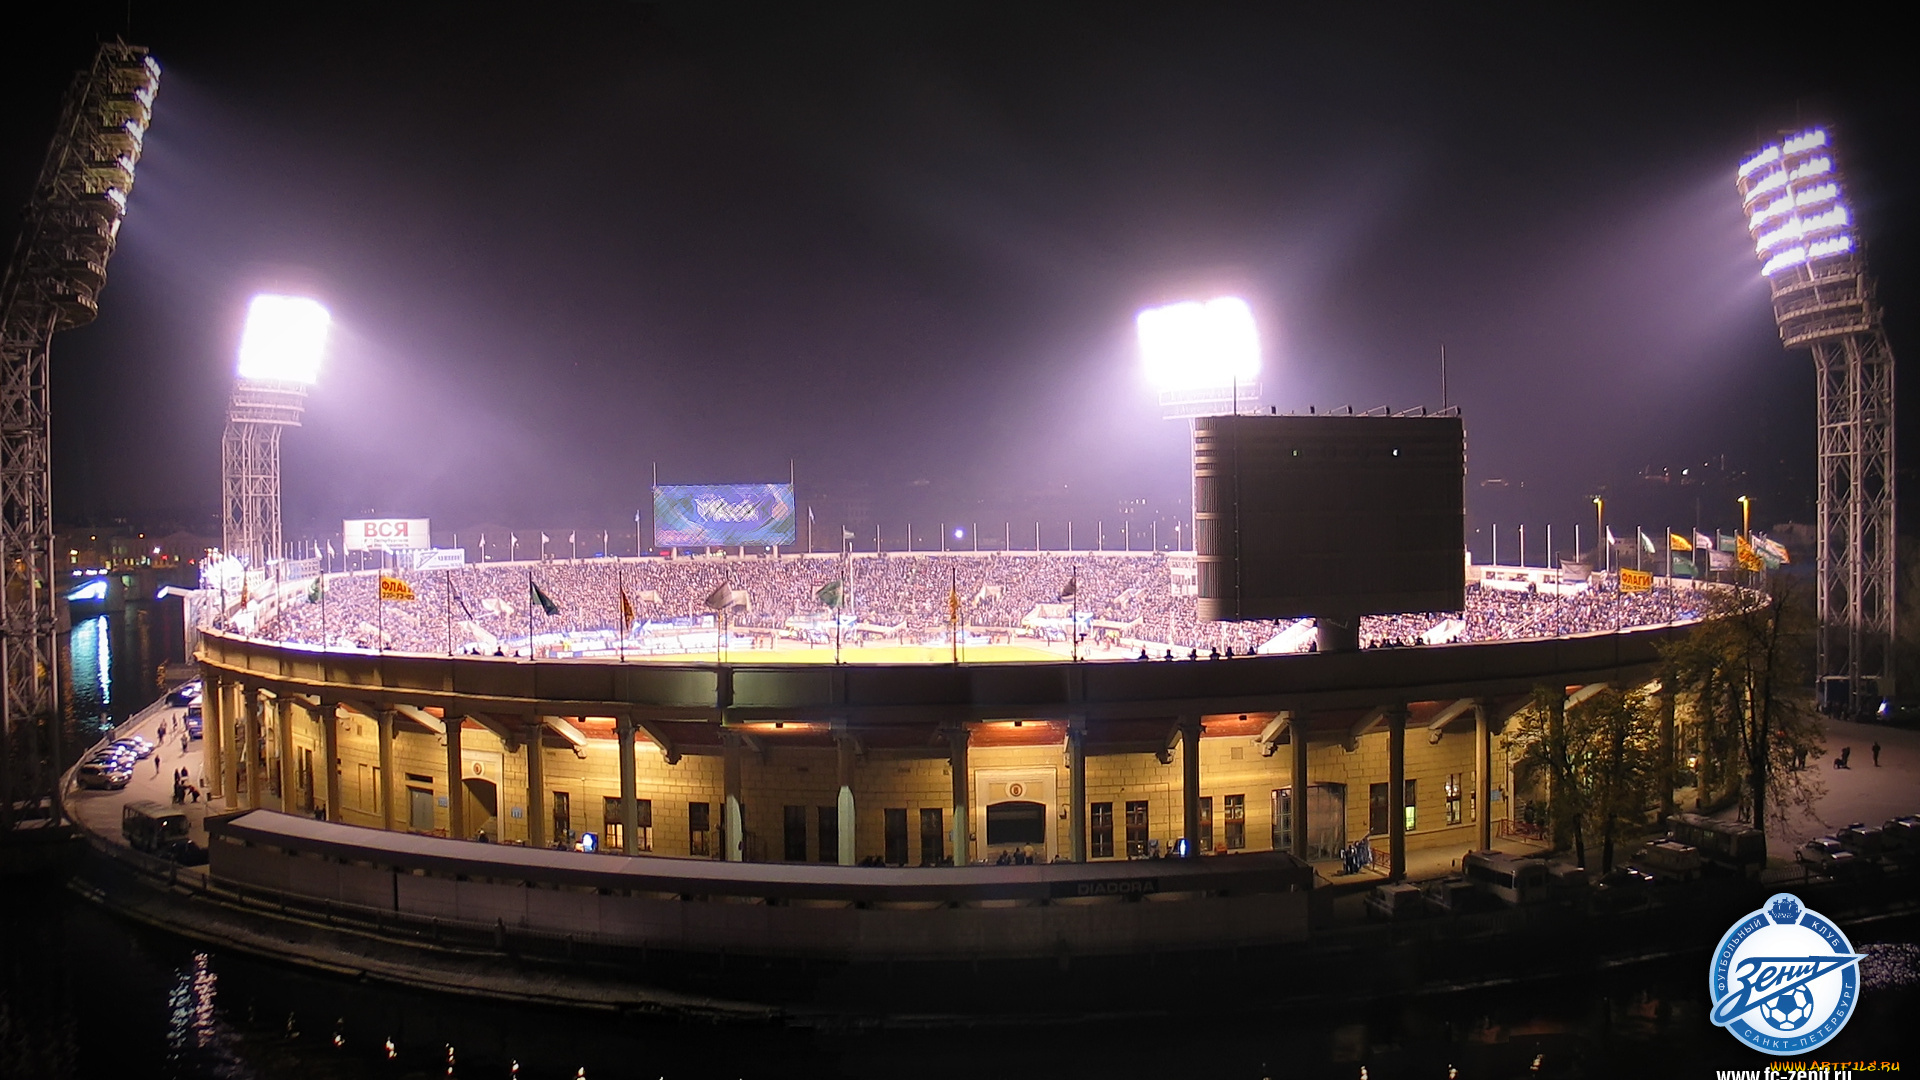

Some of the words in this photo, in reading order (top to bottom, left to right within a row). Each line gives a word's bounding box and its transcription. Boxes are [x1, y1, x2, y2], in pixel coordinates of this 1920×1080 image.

[364, 522, 408, 537] ВСЯ
[1621, 573, 1651, 586] ФЛАГИ
[1077, 880, 1154, 896] DIADORA
